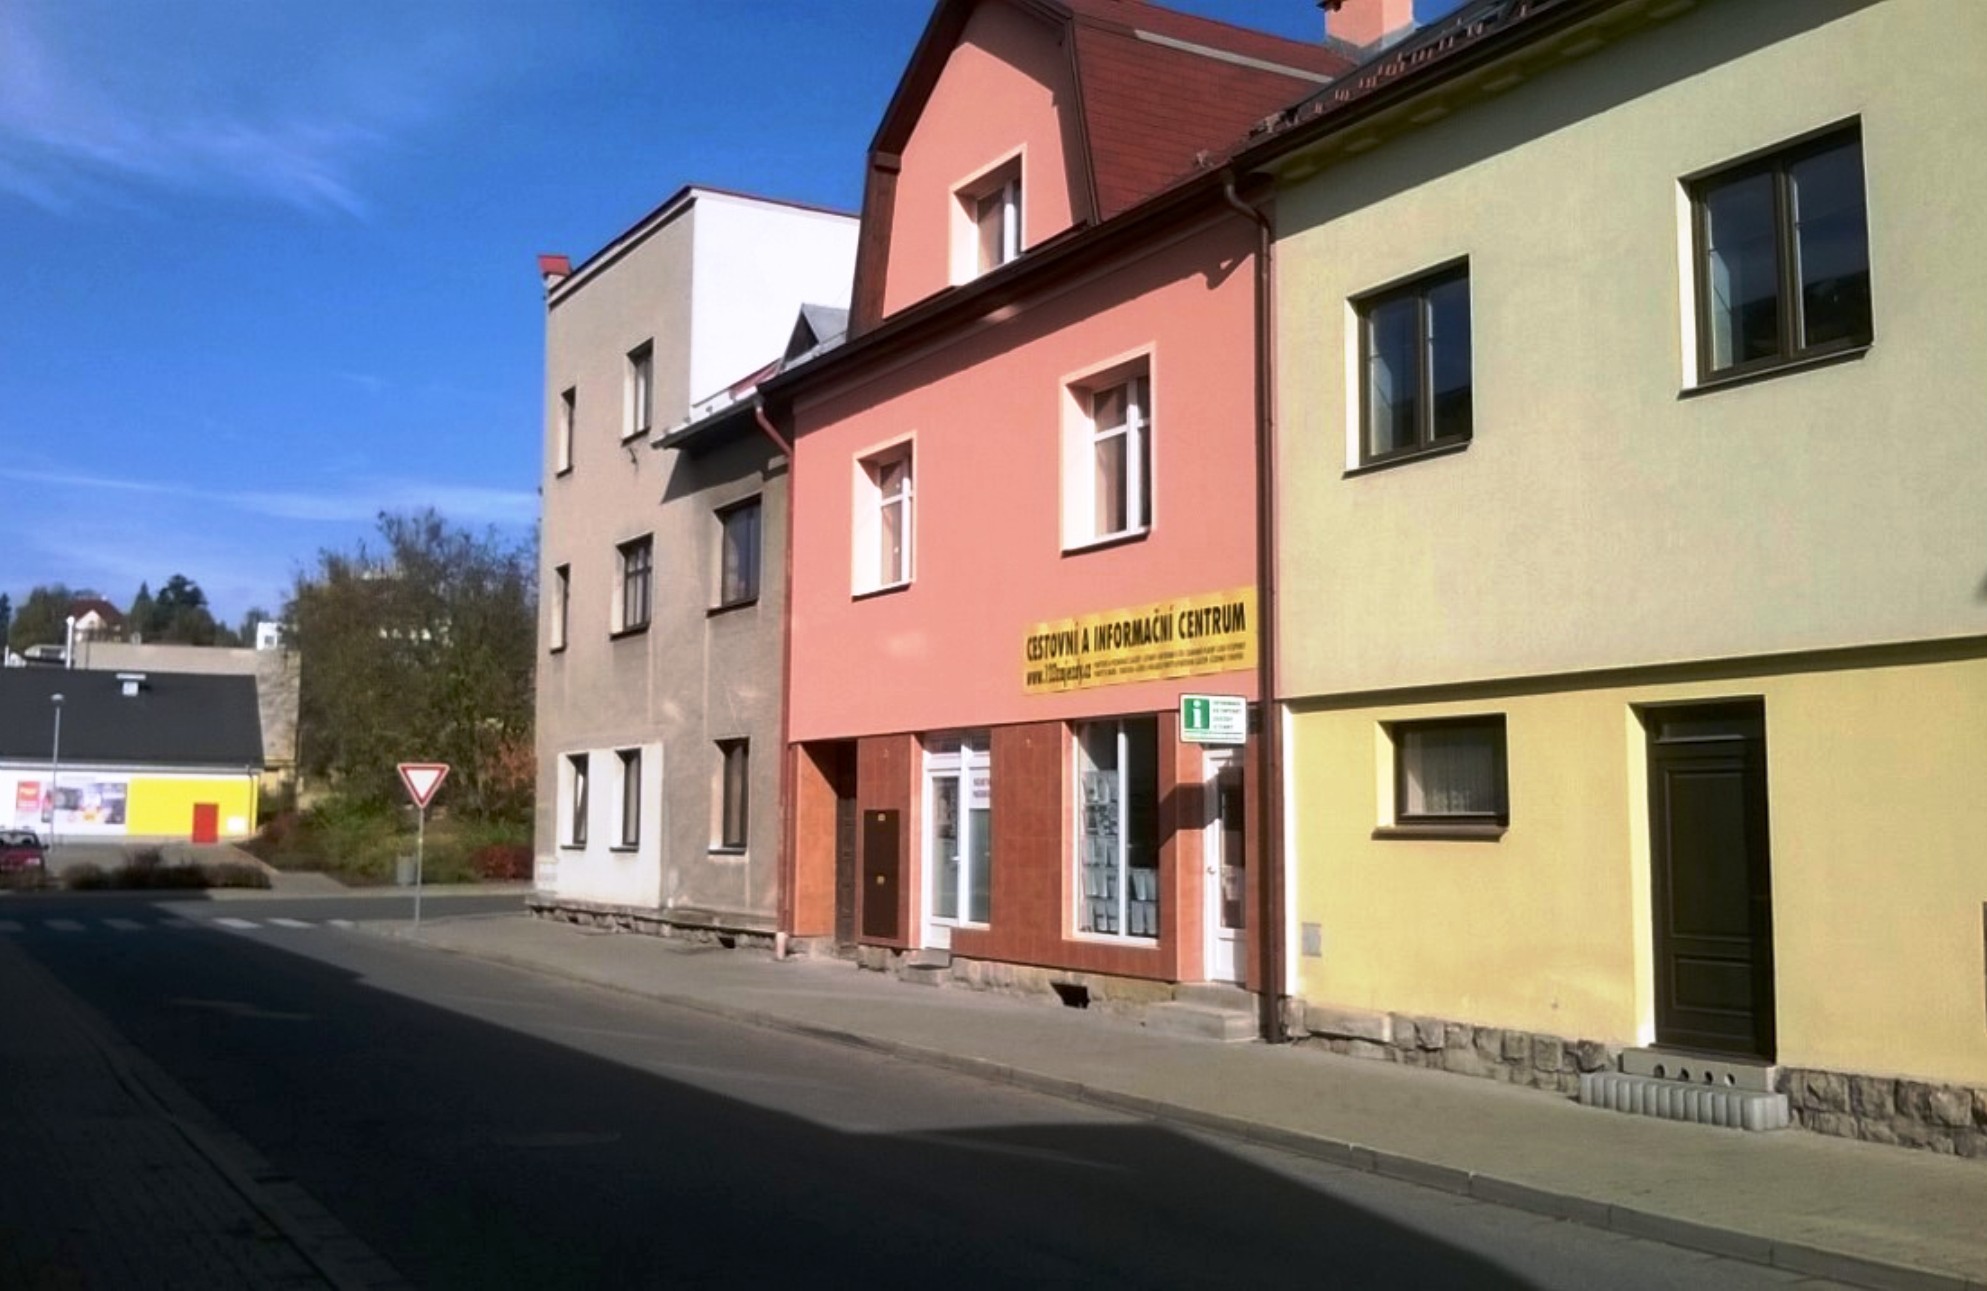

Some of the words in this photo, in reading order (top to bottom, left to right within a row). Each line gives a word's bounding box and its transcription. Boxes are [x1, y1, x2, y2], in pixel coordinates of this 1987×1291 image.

[1027, 622, 1079, 661] CESTOVNÍ
[1081, 627, 1090, 654] A
[1094, 605, 1173, 652] INFORMAČNÍ
[1178, 602, 1246, 640] CENTRUM
